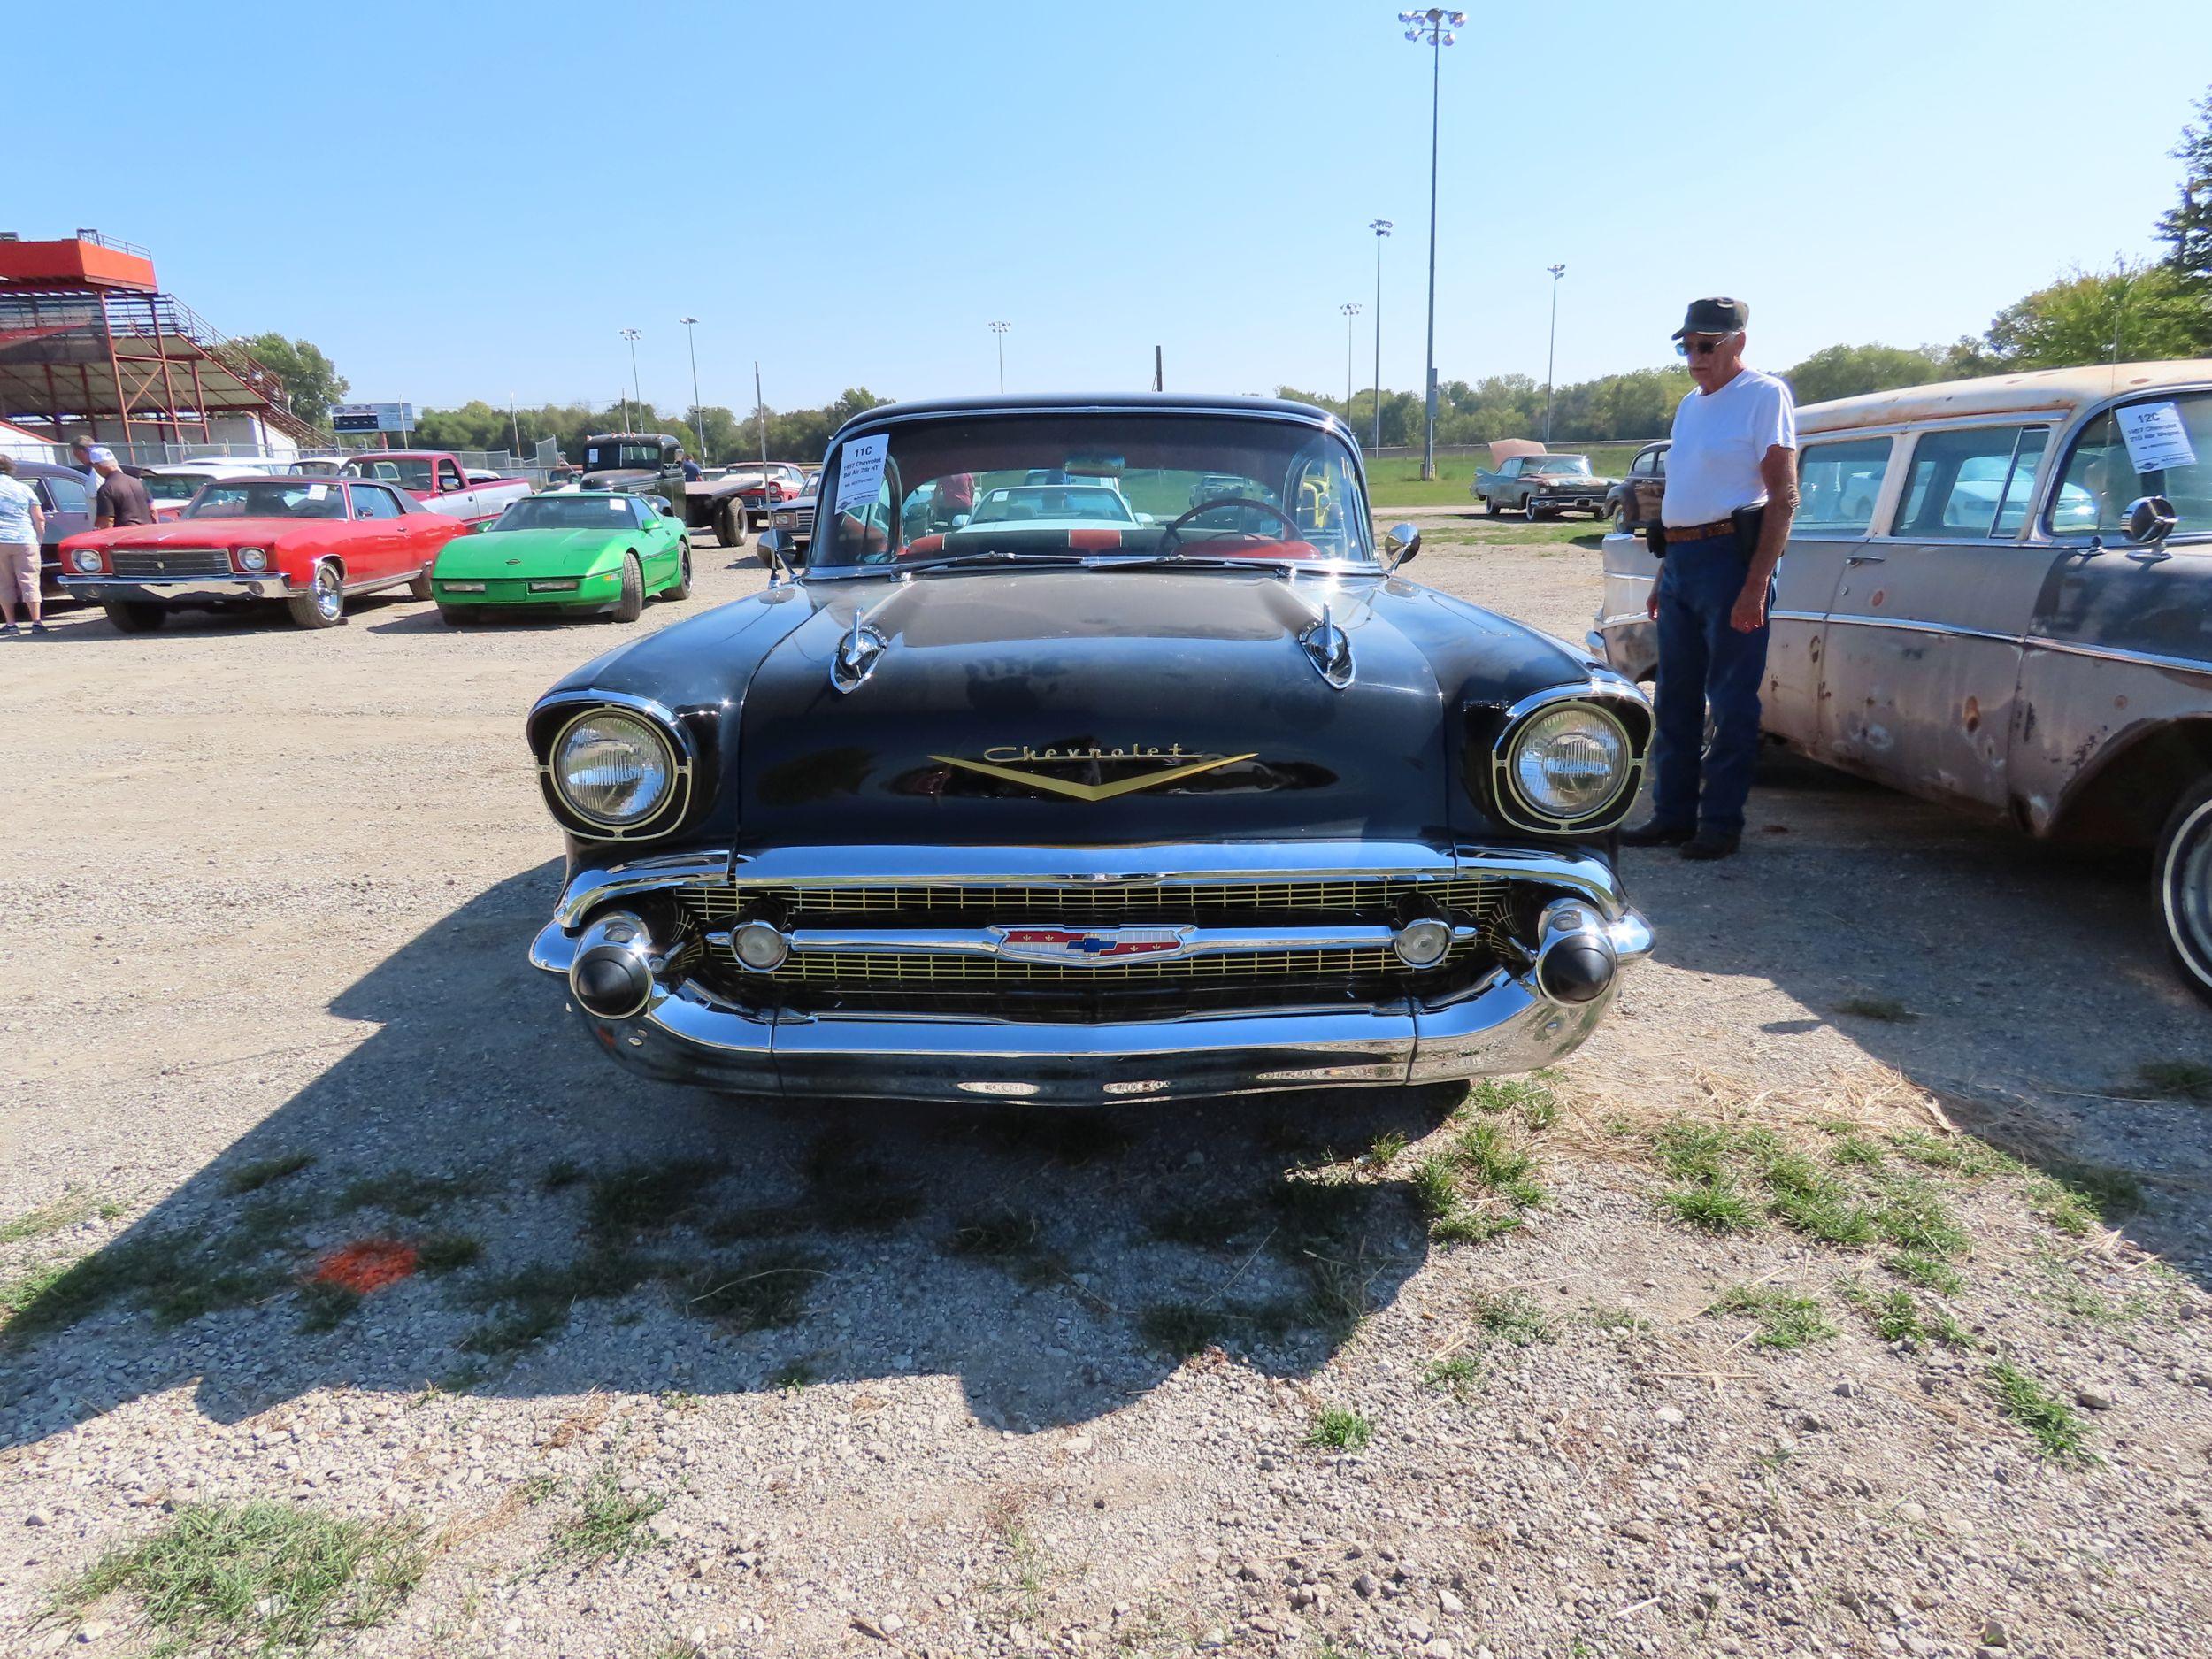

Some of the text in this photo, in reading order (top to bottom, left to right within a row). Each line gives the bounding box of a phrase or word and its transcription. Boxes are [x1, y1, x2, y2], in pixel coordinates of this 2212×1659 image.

[2137, 412, 2160, 423] 12C
[855, 446, 872, 457] 11C
[984, 743, 1202, 762] Chevrolet
